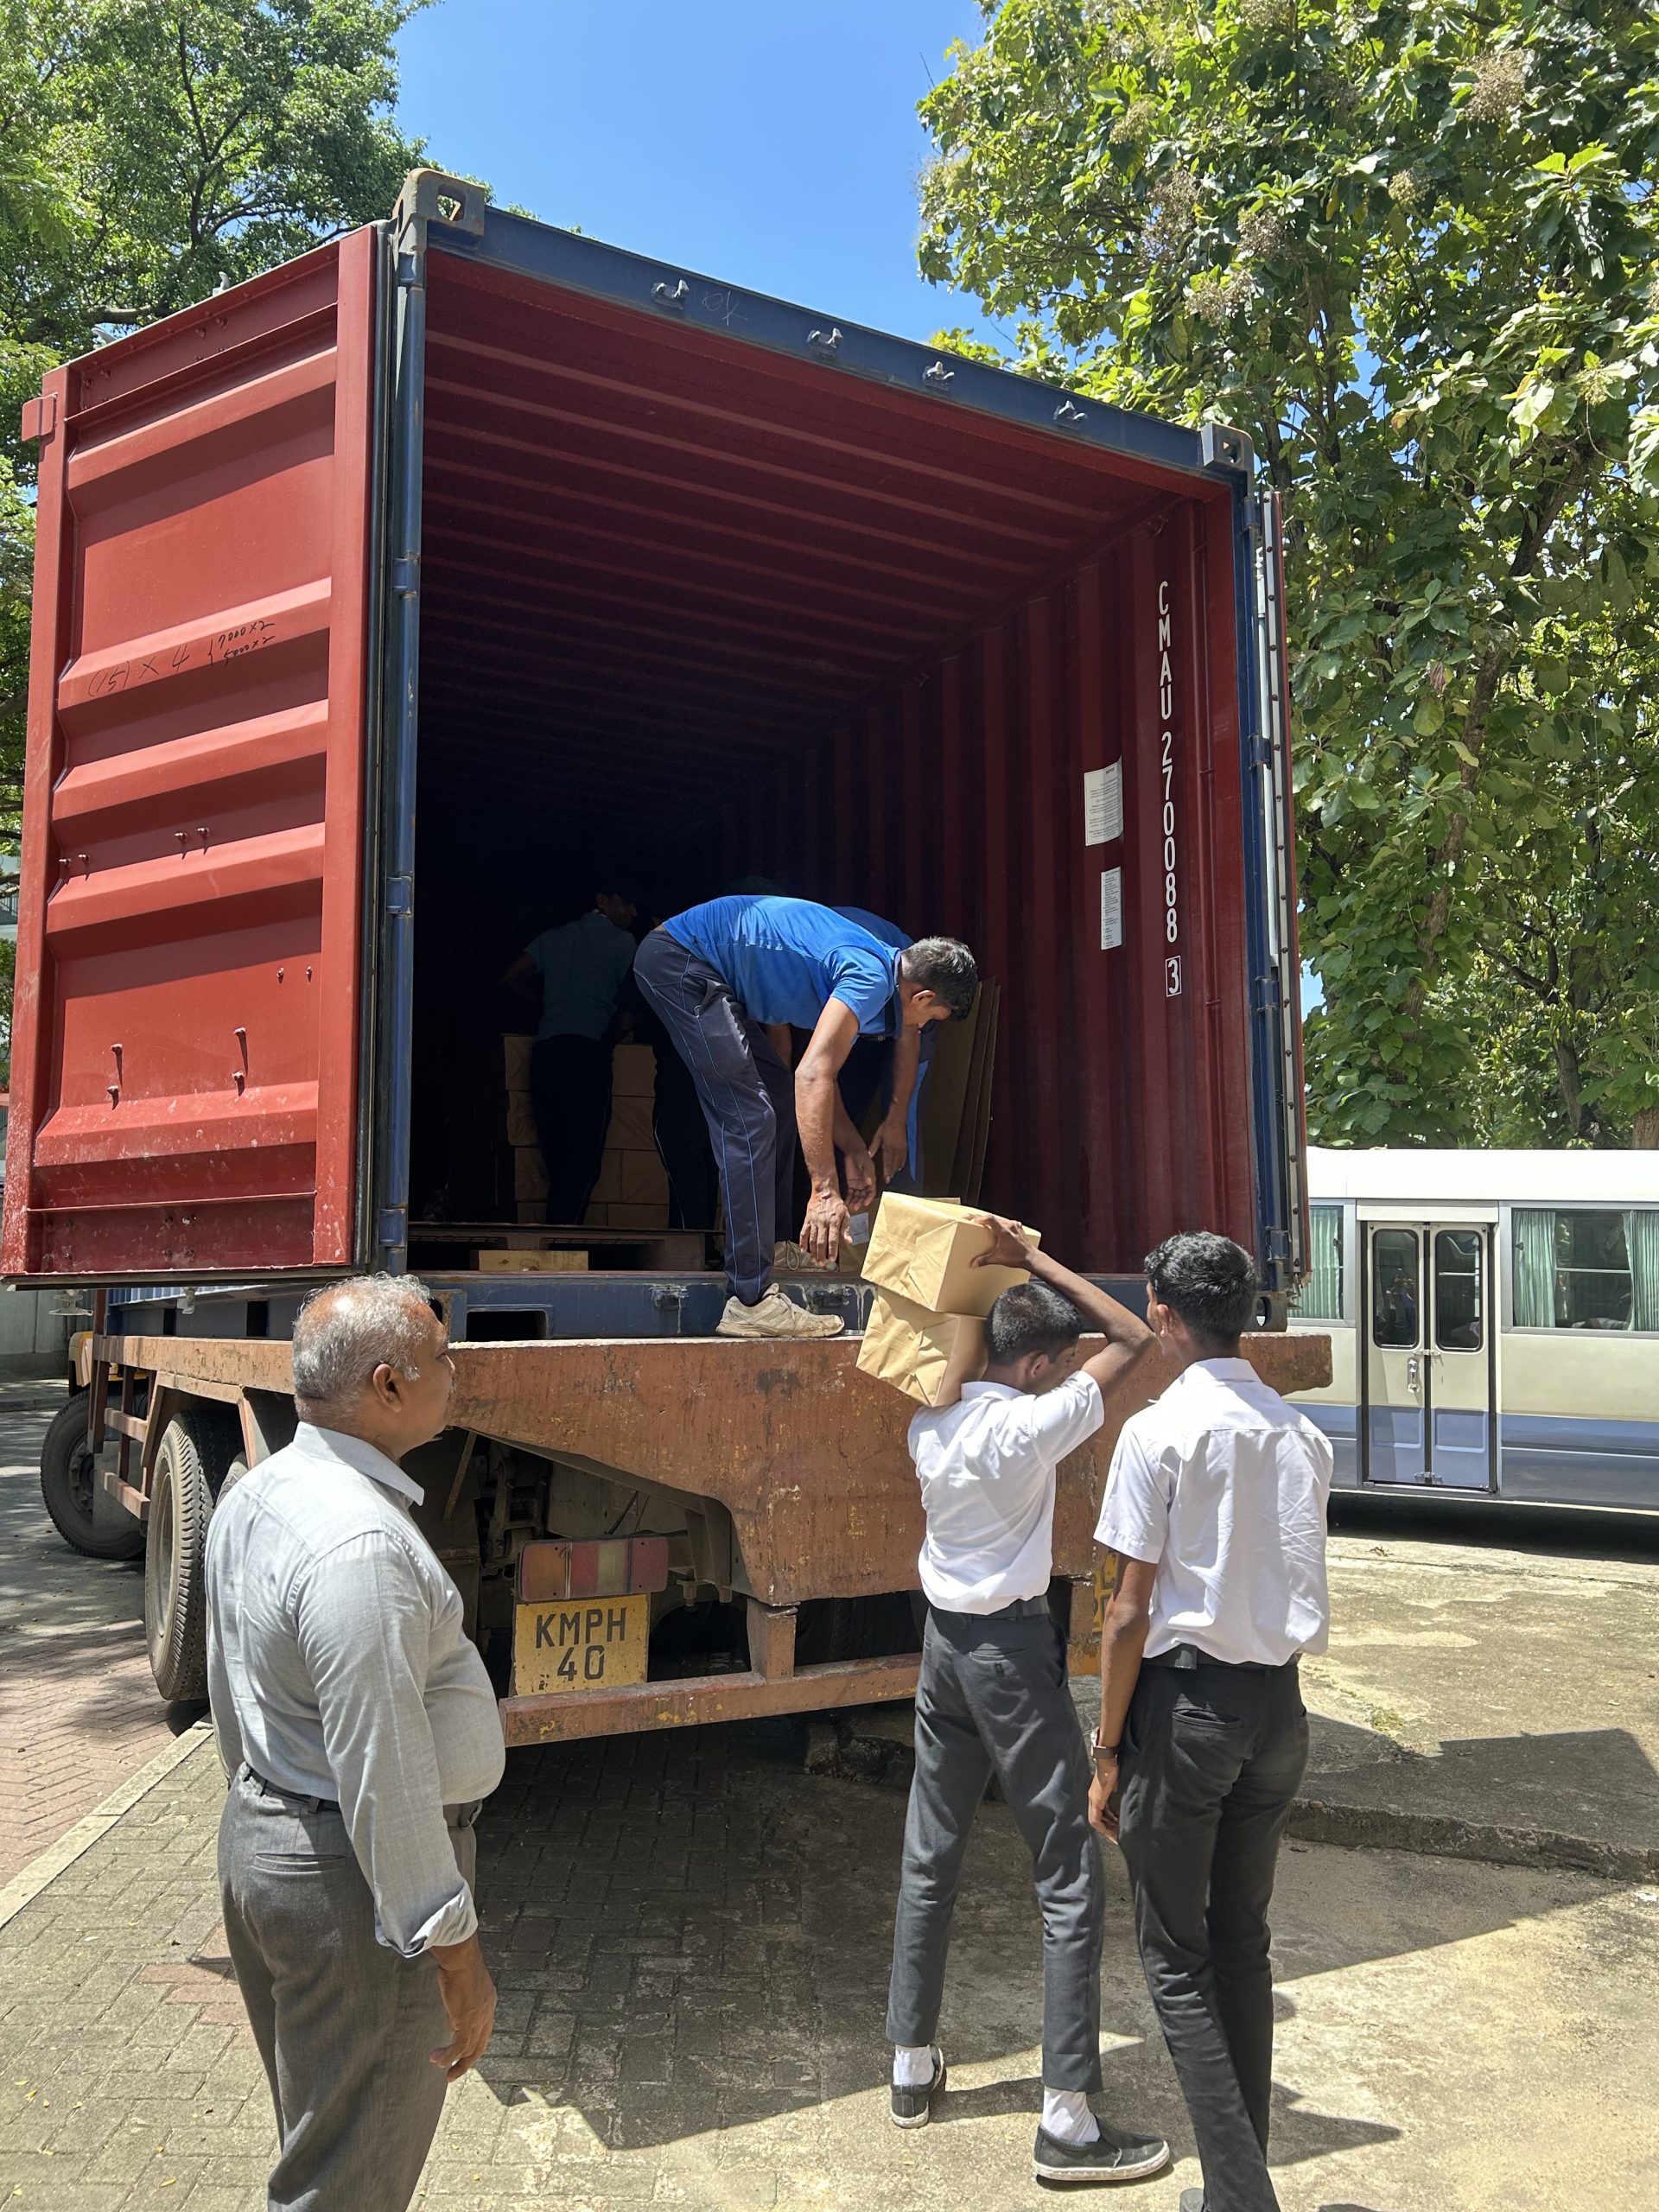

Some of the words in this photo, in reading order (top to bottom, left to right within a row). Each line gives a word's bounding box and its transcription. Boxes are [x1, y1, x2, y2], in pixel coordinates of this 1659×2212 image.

[1158, 580, 1173, 721] CMAU
[1161, 731, 1178, 943] 270088
[1167, 959, 1179, 995] 3
[536, 1607, 627, 1649] KMPH
[556, 1644, 606, 1681] 40
